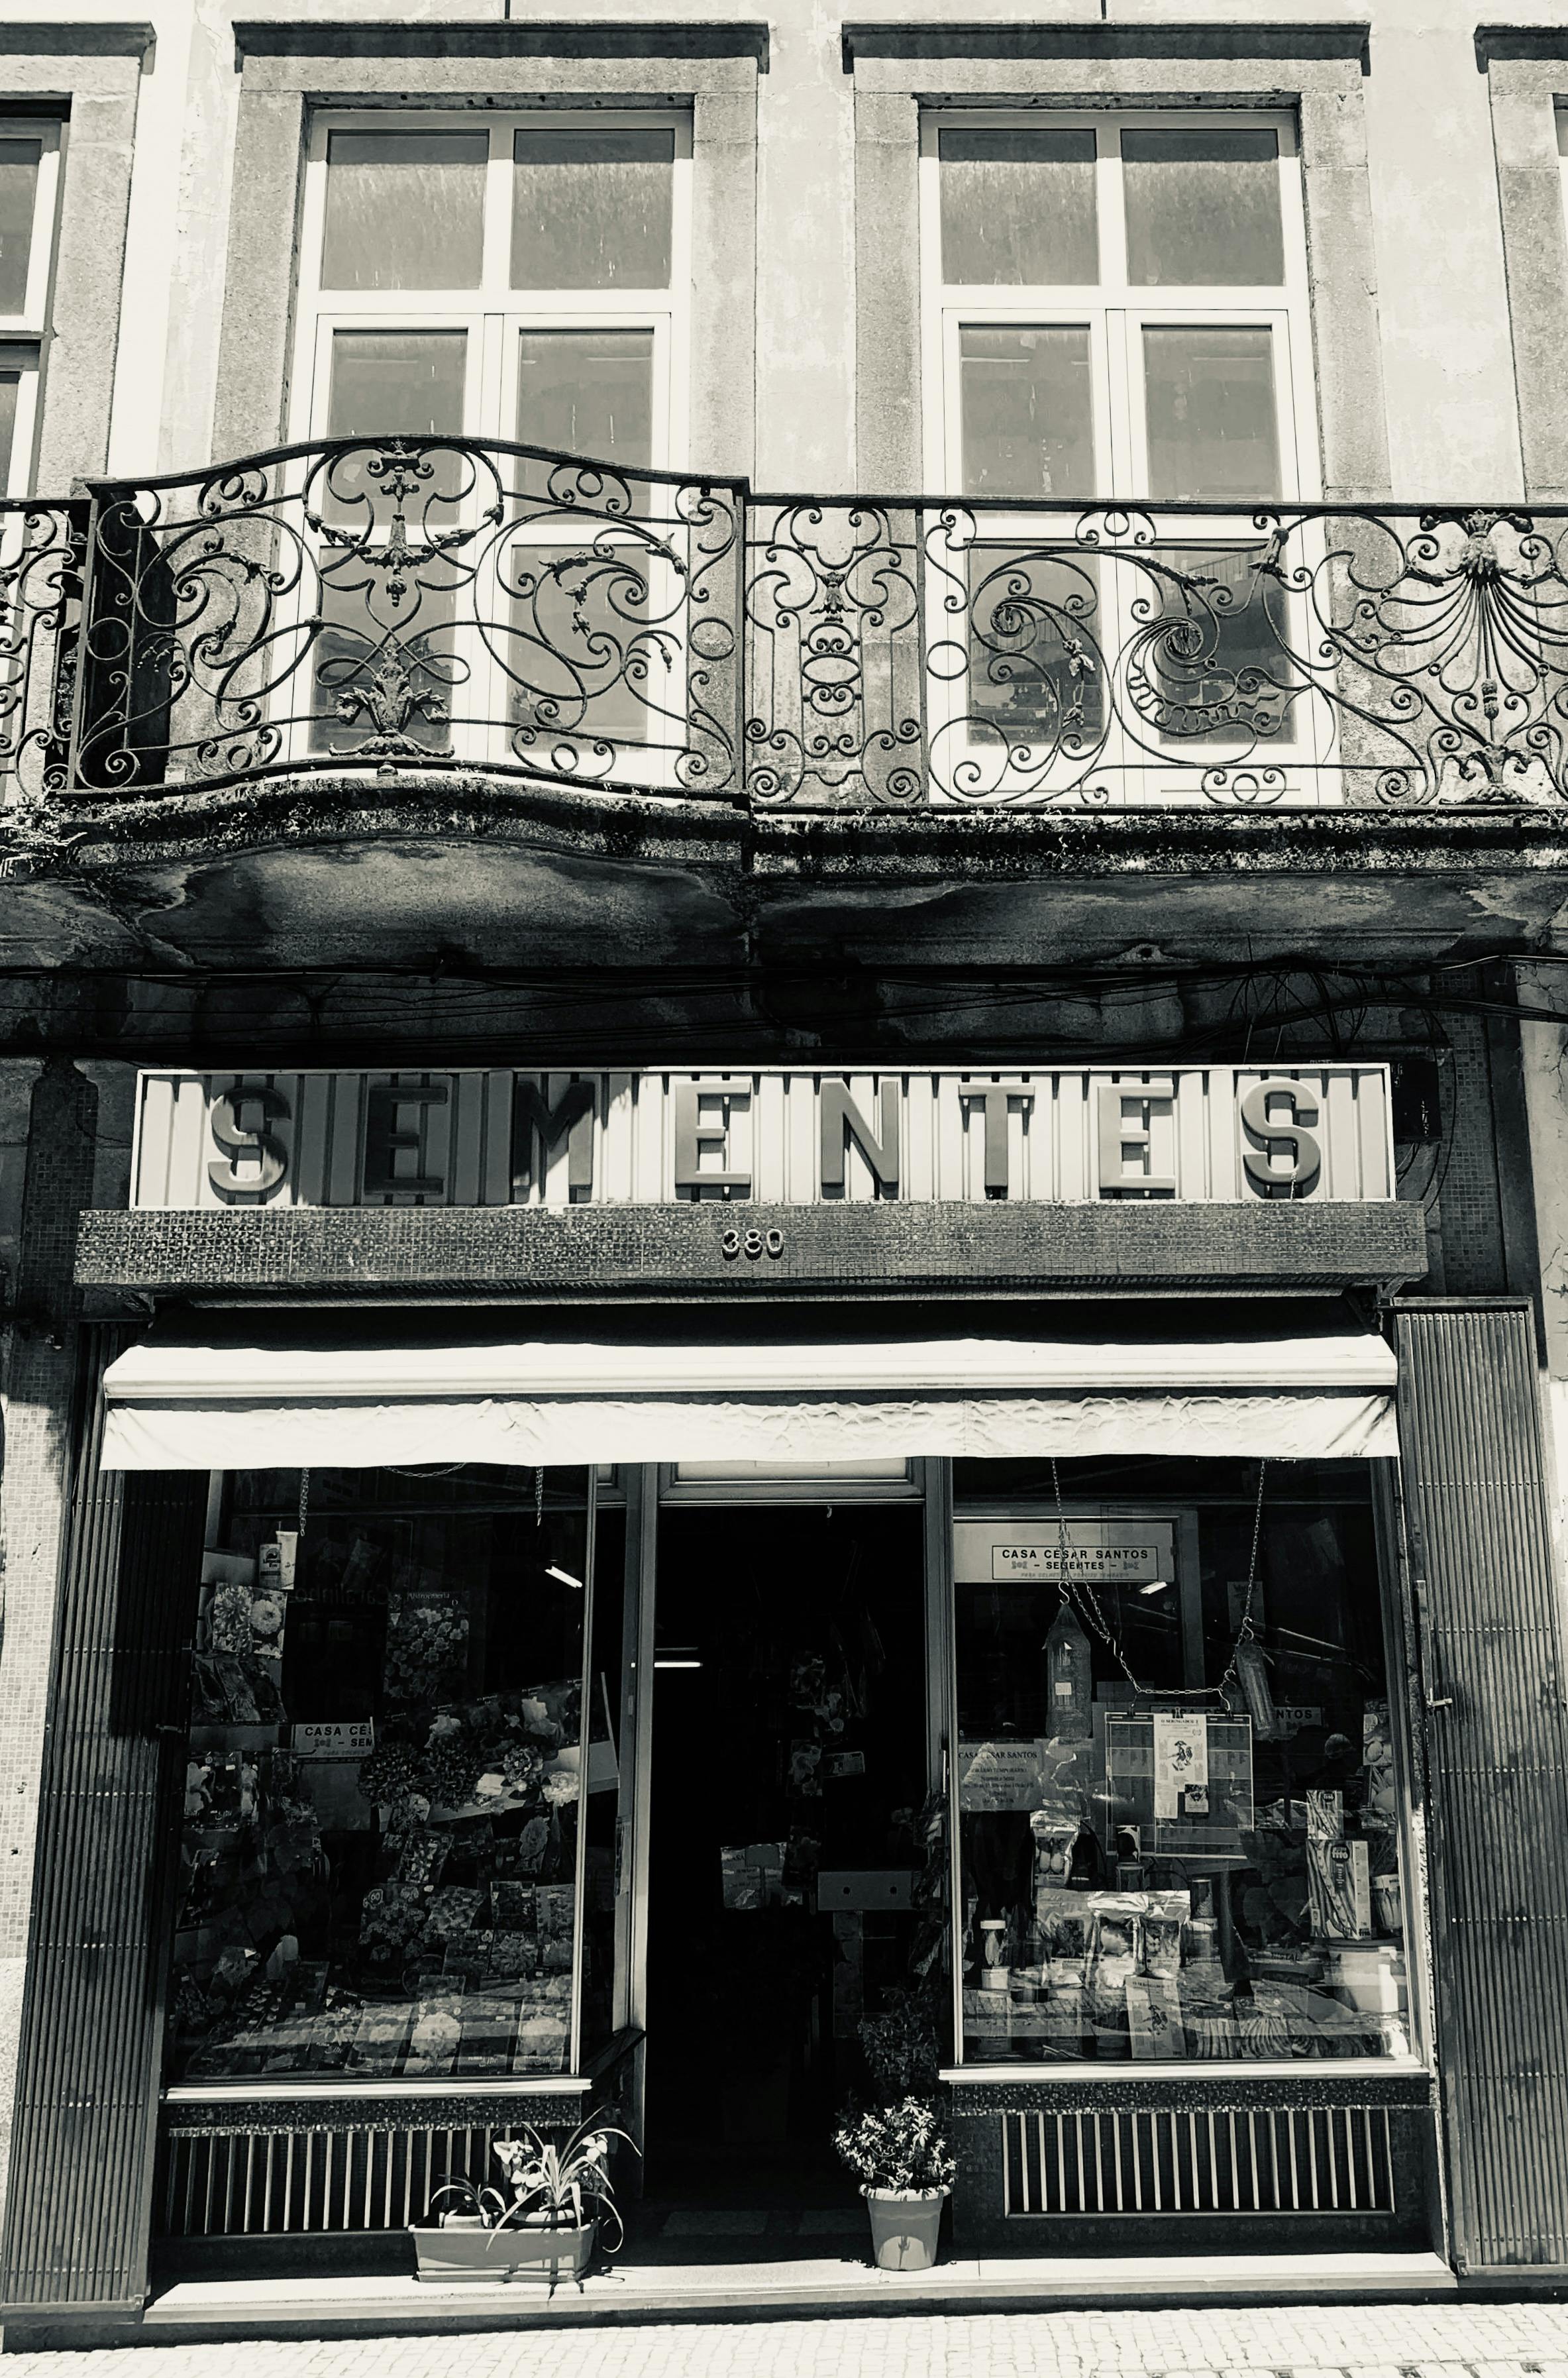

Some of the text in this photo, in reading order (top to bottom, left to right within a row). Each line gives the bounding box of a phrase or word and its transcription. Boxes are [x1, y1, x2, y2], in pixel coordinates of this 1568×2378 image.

[207, 1078, 1321, 1194] SEMENTES
[721, 1228, 784, 1257] 380
[1002, 1548, 1148, 1559] CASA CÉSAR SANTOS
[1276, 1709, 1312, 1719] NTOS
[305, 1726, 341, 1736] CASA
